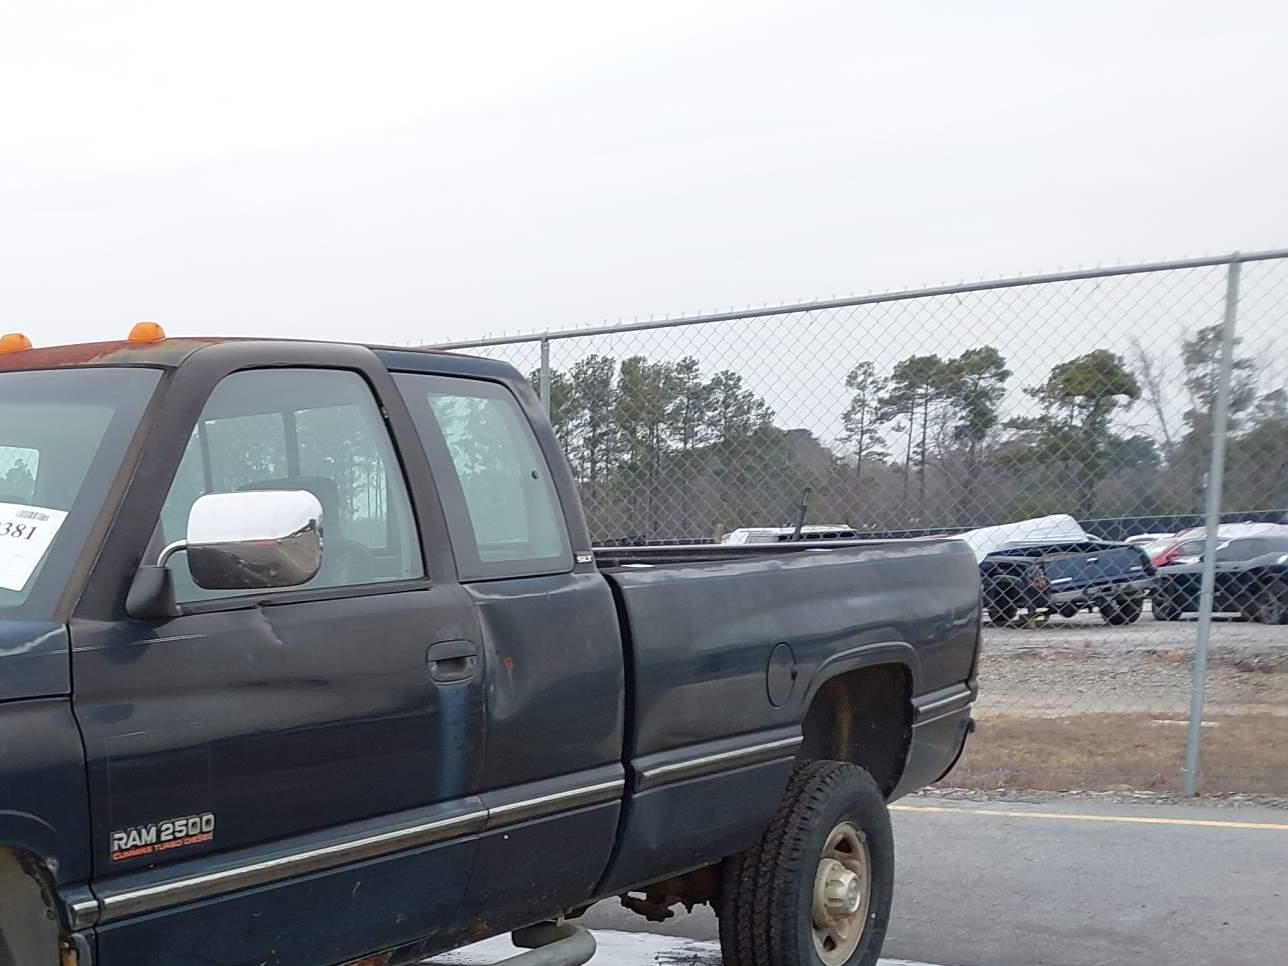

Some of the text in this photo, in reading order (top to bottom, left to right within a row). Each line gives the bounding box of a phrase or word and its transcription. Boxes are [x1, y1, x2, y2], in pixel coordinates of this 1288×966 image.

[112, 813, 215, 851] RAM 2500
[154, 839, 183, 852] TURBO
